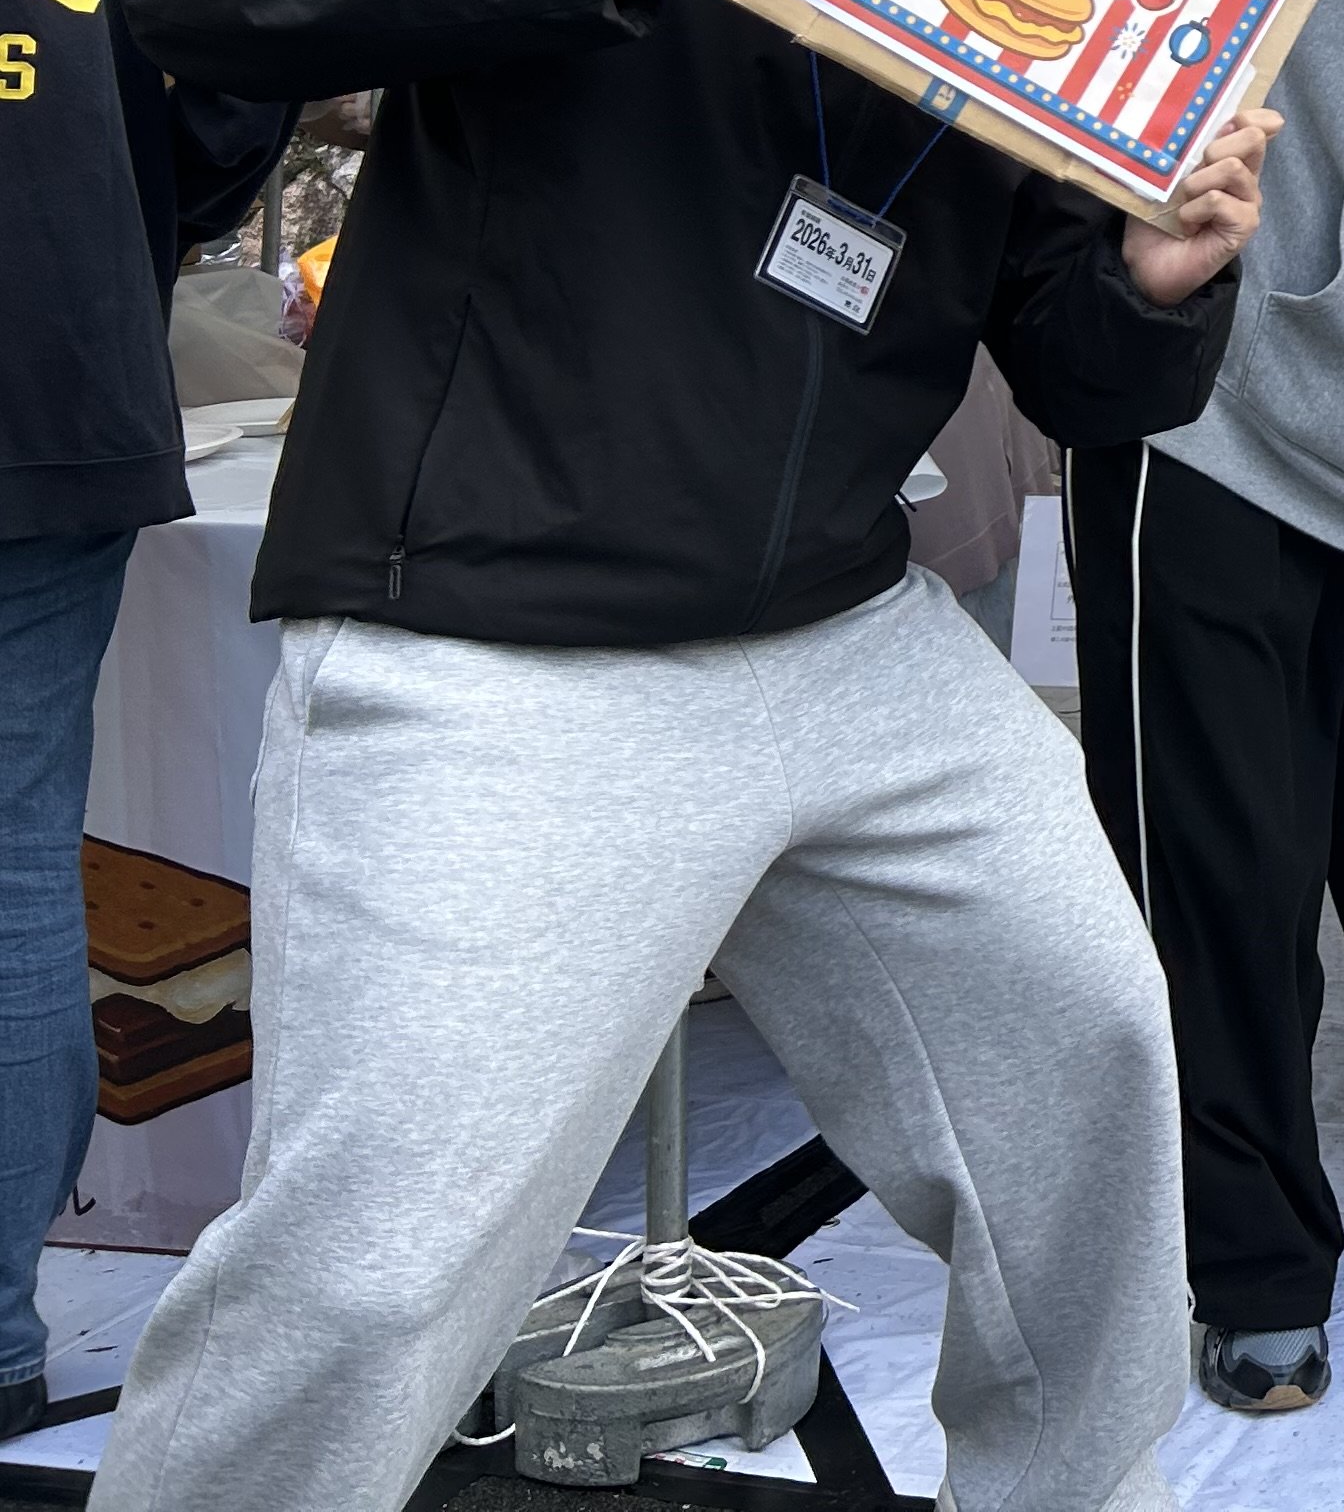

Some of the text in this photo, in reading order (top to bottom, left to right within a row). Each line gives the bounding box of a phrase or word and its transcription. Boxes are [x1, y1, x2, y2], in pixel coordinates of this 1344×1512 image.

[0, 33, 37, 101] S
[790, 218, 877, 283] 2026年3月31日
